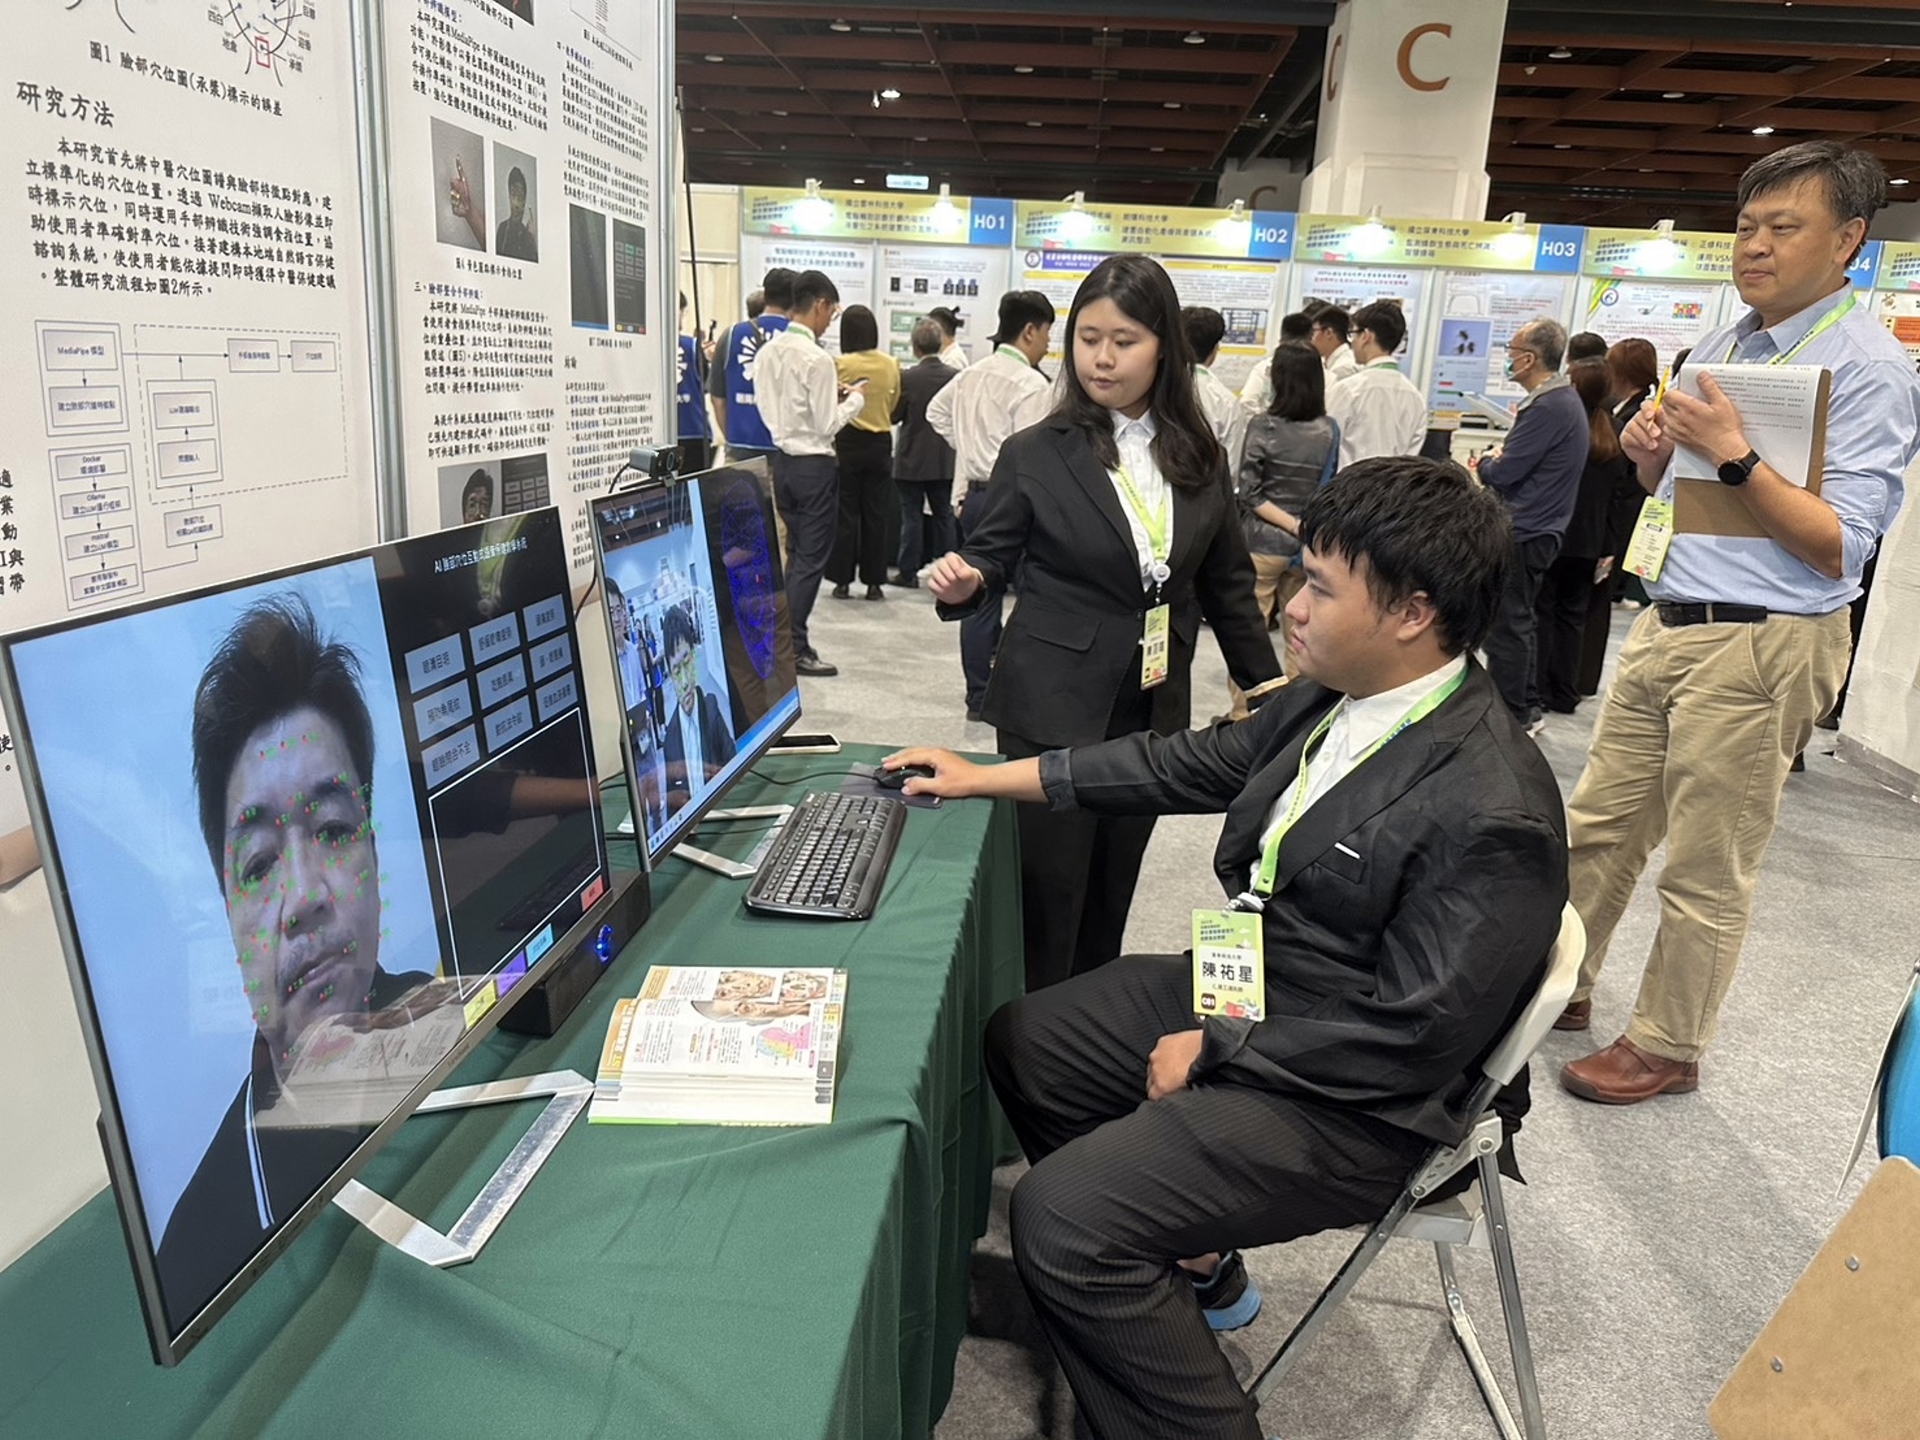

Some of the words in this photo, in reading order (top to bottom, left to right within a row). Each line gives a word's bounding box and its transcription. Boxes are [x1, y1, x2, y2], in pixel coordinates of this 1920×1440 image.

[1396, 22, 1452, 92] C
[1326, 34, 1342, 102] C
[17, 81, 115, 128] 研究方法
[974, 214, 1005, 230] H01
[1254, 228, 1288, 244] H02
[1699, 240, 1734, 250] 正修科技
[1541, 242, 1575, 257] H03
[1202, 960, 1254, 984] 陳祐星
